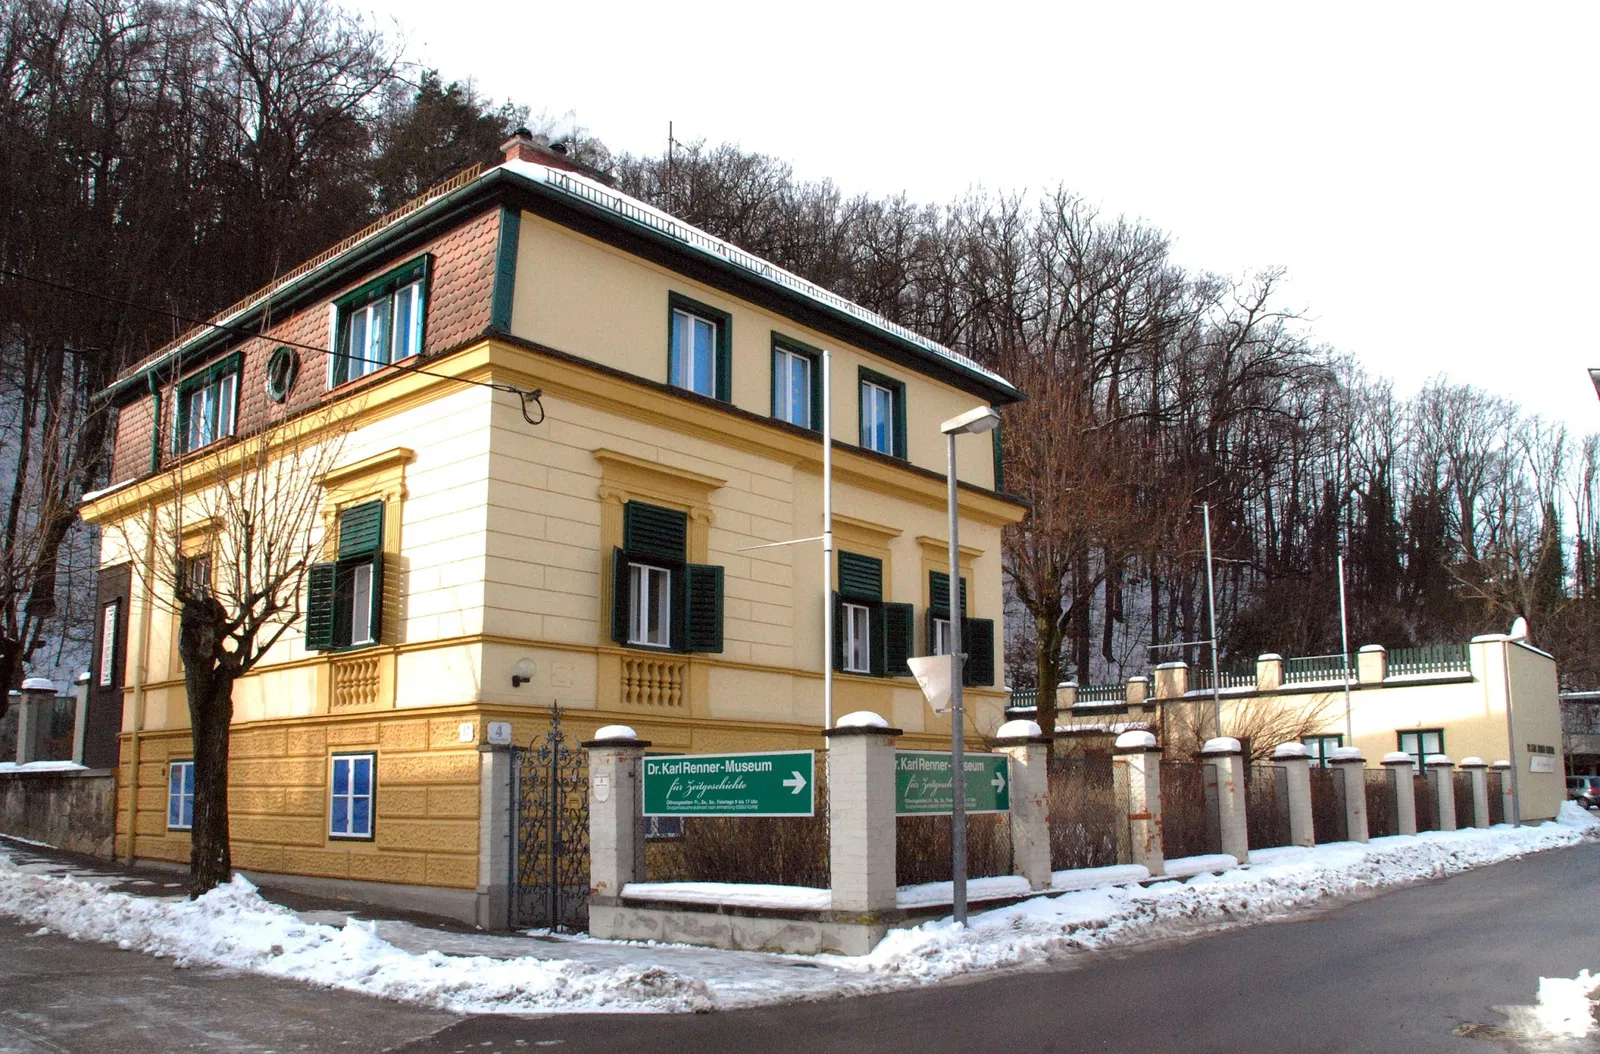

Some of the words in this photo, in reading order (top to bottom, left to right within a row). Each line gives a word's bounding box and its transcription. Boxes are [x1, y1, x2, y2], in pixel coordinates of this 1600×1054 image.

[495, 724, 503, 737] 4
[648, 763, 661, 775] Dr.
[662, 762, 682, 774] Karl
[683, 760, 772, 773] Renner-Museum
[900, 757, 918, 771] Karl
[919, 758, 984, 771] Renner-seum
[666, 777, 682, 799] für
[683, 775, 746, 798] Zeitgeschichte
